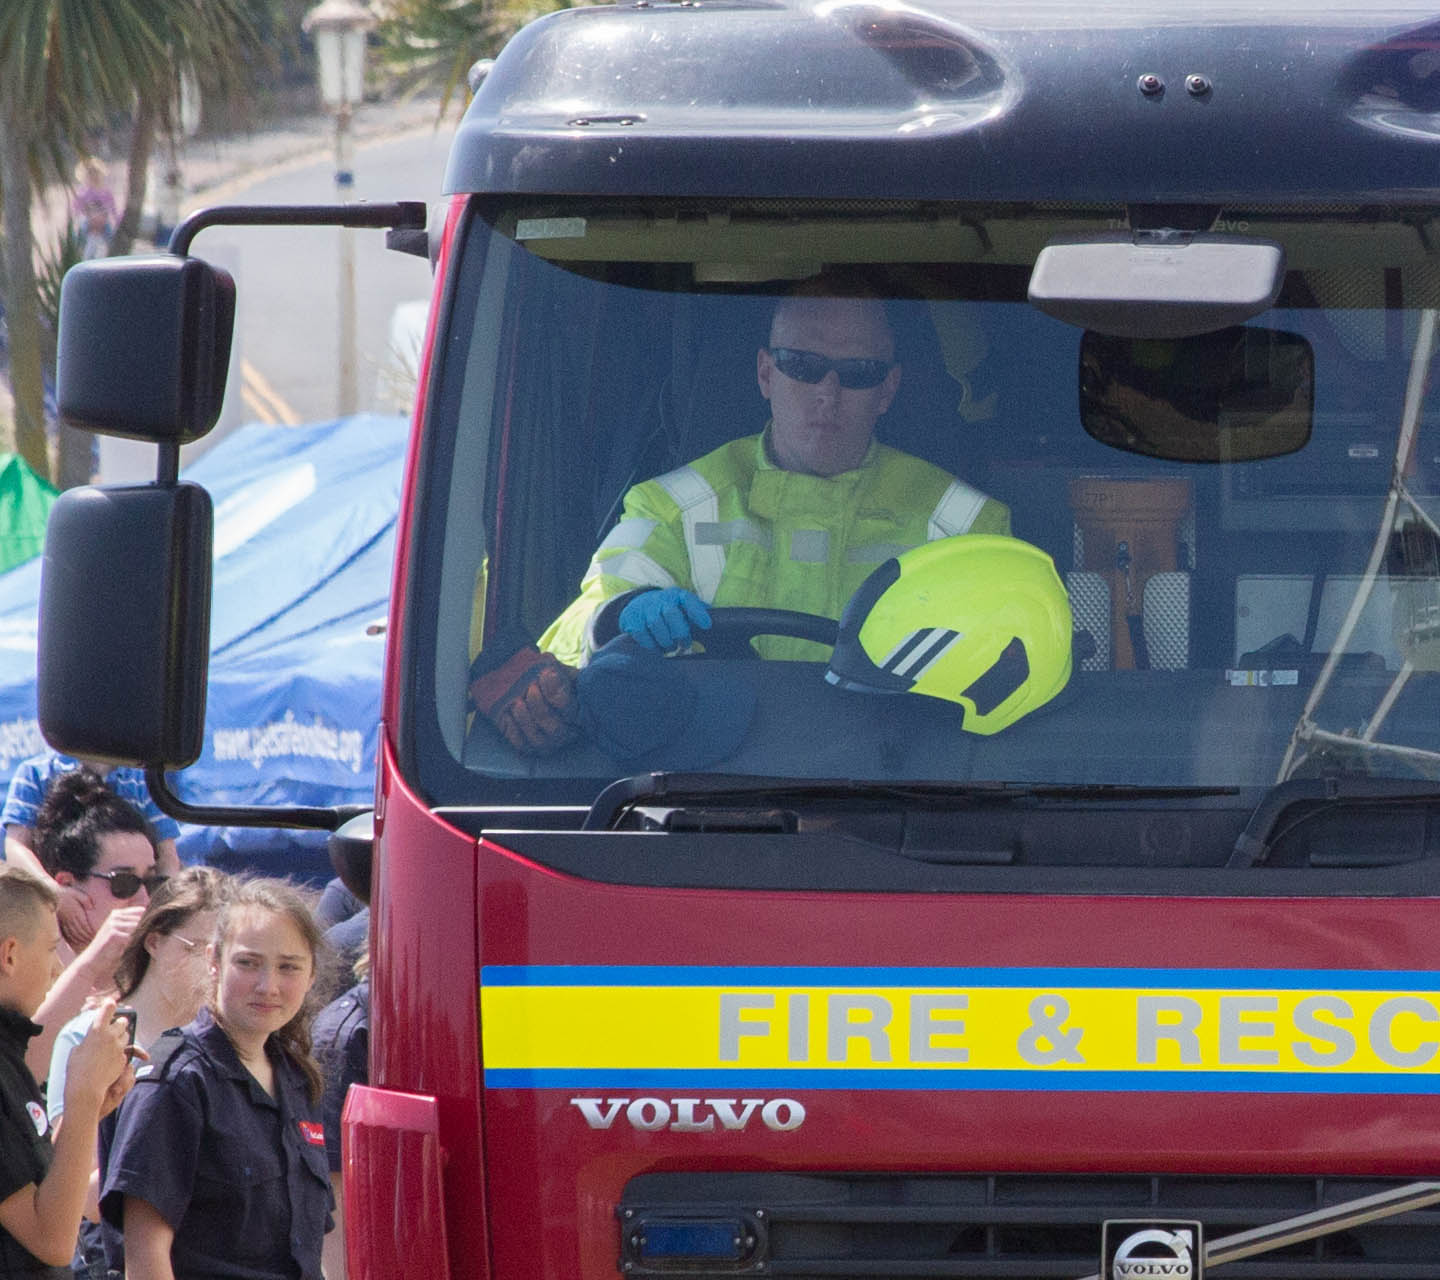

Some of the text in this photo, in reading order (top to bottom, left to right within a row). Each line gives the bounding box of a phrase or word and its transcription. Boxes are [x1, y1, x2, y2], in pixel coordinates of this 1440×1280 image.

[718, 993, 970, 1063] FIRE
[1016, 993, 1088, 1067] &
[569, 1097, 807, 1133] VOLVO
[1116, 1264, 1190, 1275] VOLVO
